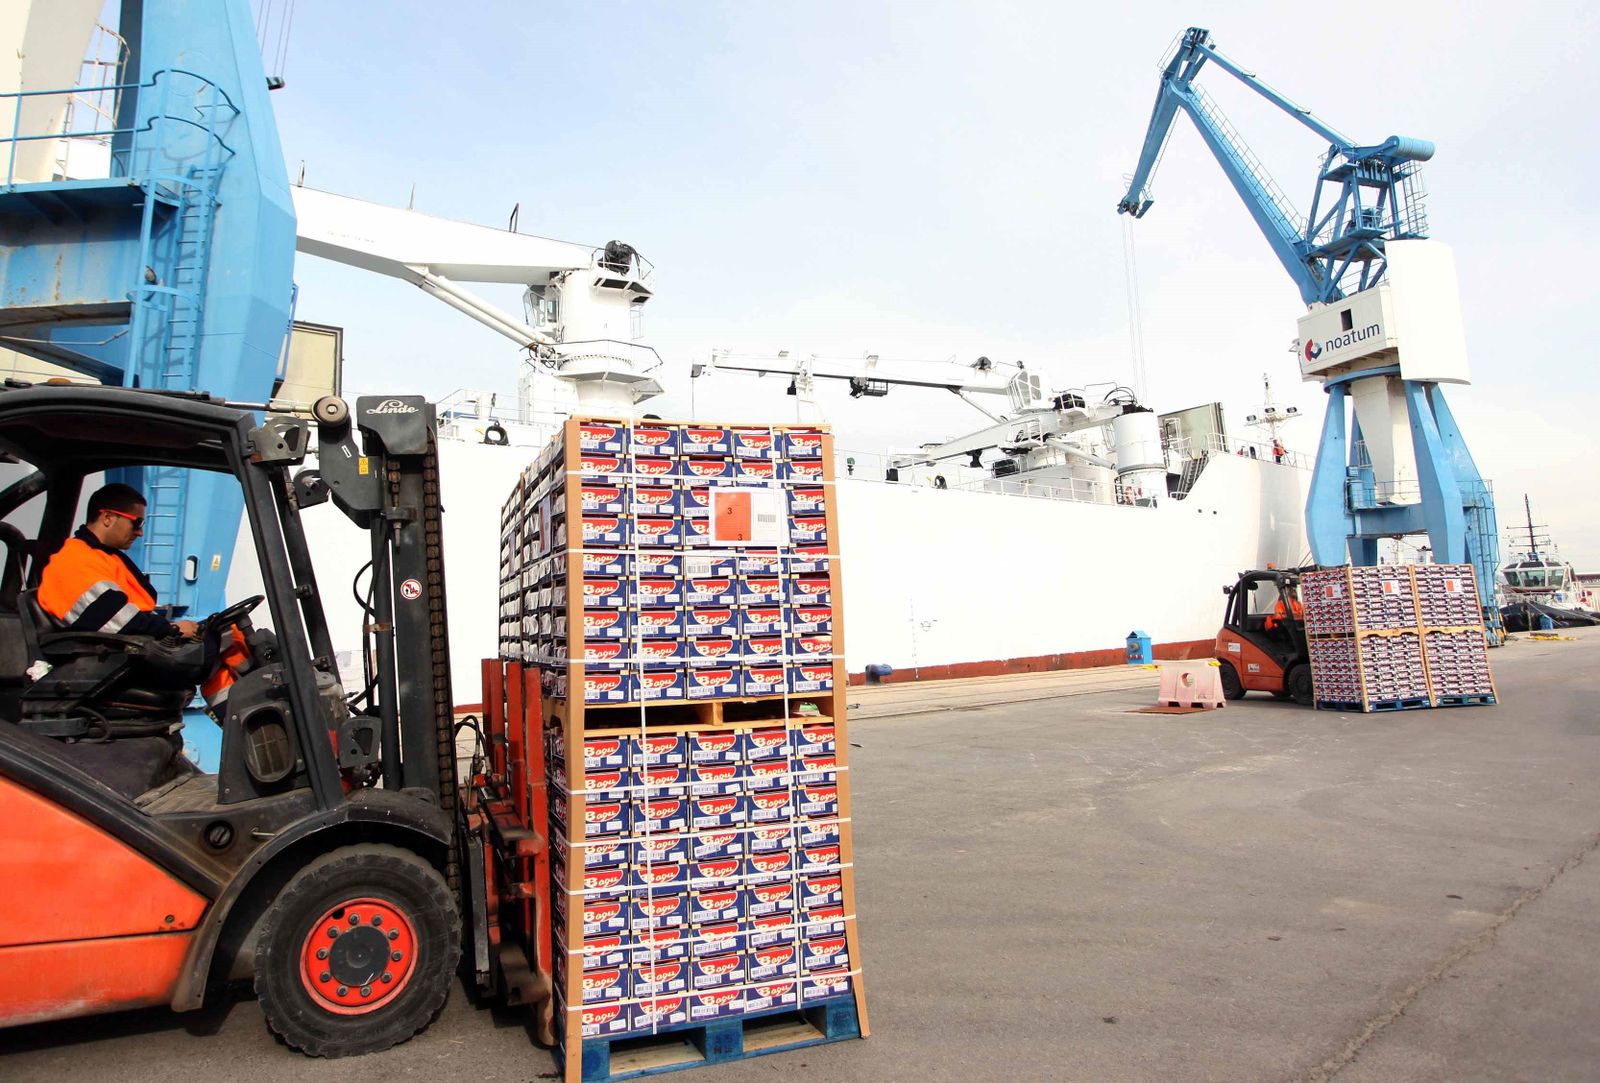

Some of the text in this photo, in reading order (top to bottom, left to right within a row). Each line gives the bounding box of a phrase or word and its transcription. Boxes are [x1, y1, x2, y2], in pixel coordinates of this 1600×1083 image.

[1326, 323, 1380, 351] noatum
[366, 399, 419, 414] Linde
[727, 507, 733, 515] 3
